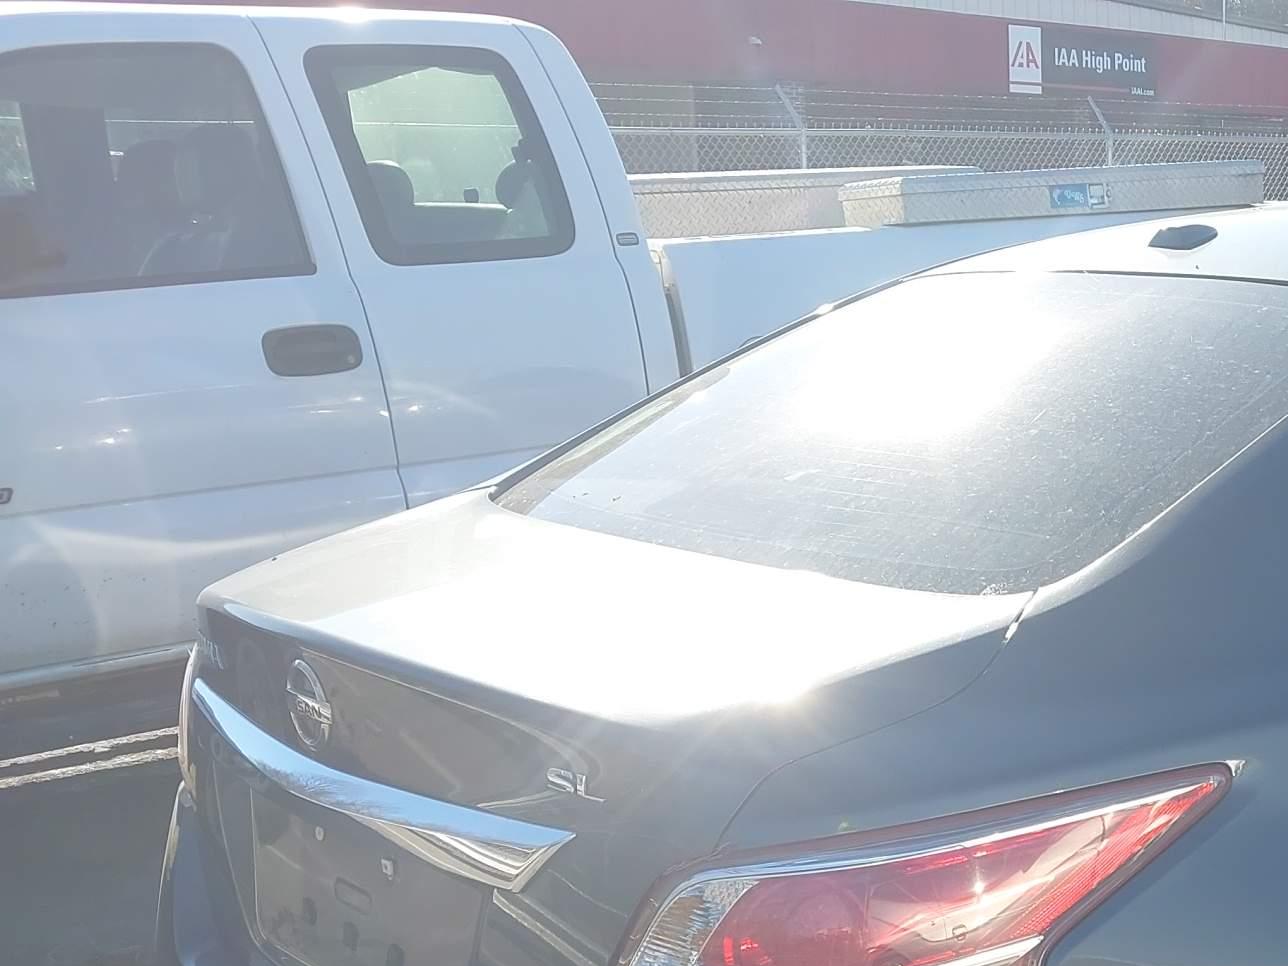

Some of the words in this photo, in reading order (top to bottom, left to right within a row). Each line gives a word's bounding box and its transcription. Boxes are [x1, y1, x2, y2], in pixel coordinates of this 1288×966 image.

[1054, 47, 1079, 68] IAA
[1082, 49, 1111, 74] High
[1114, 52, 1147, 73] Point
[546, 767, 607, 802] SL
